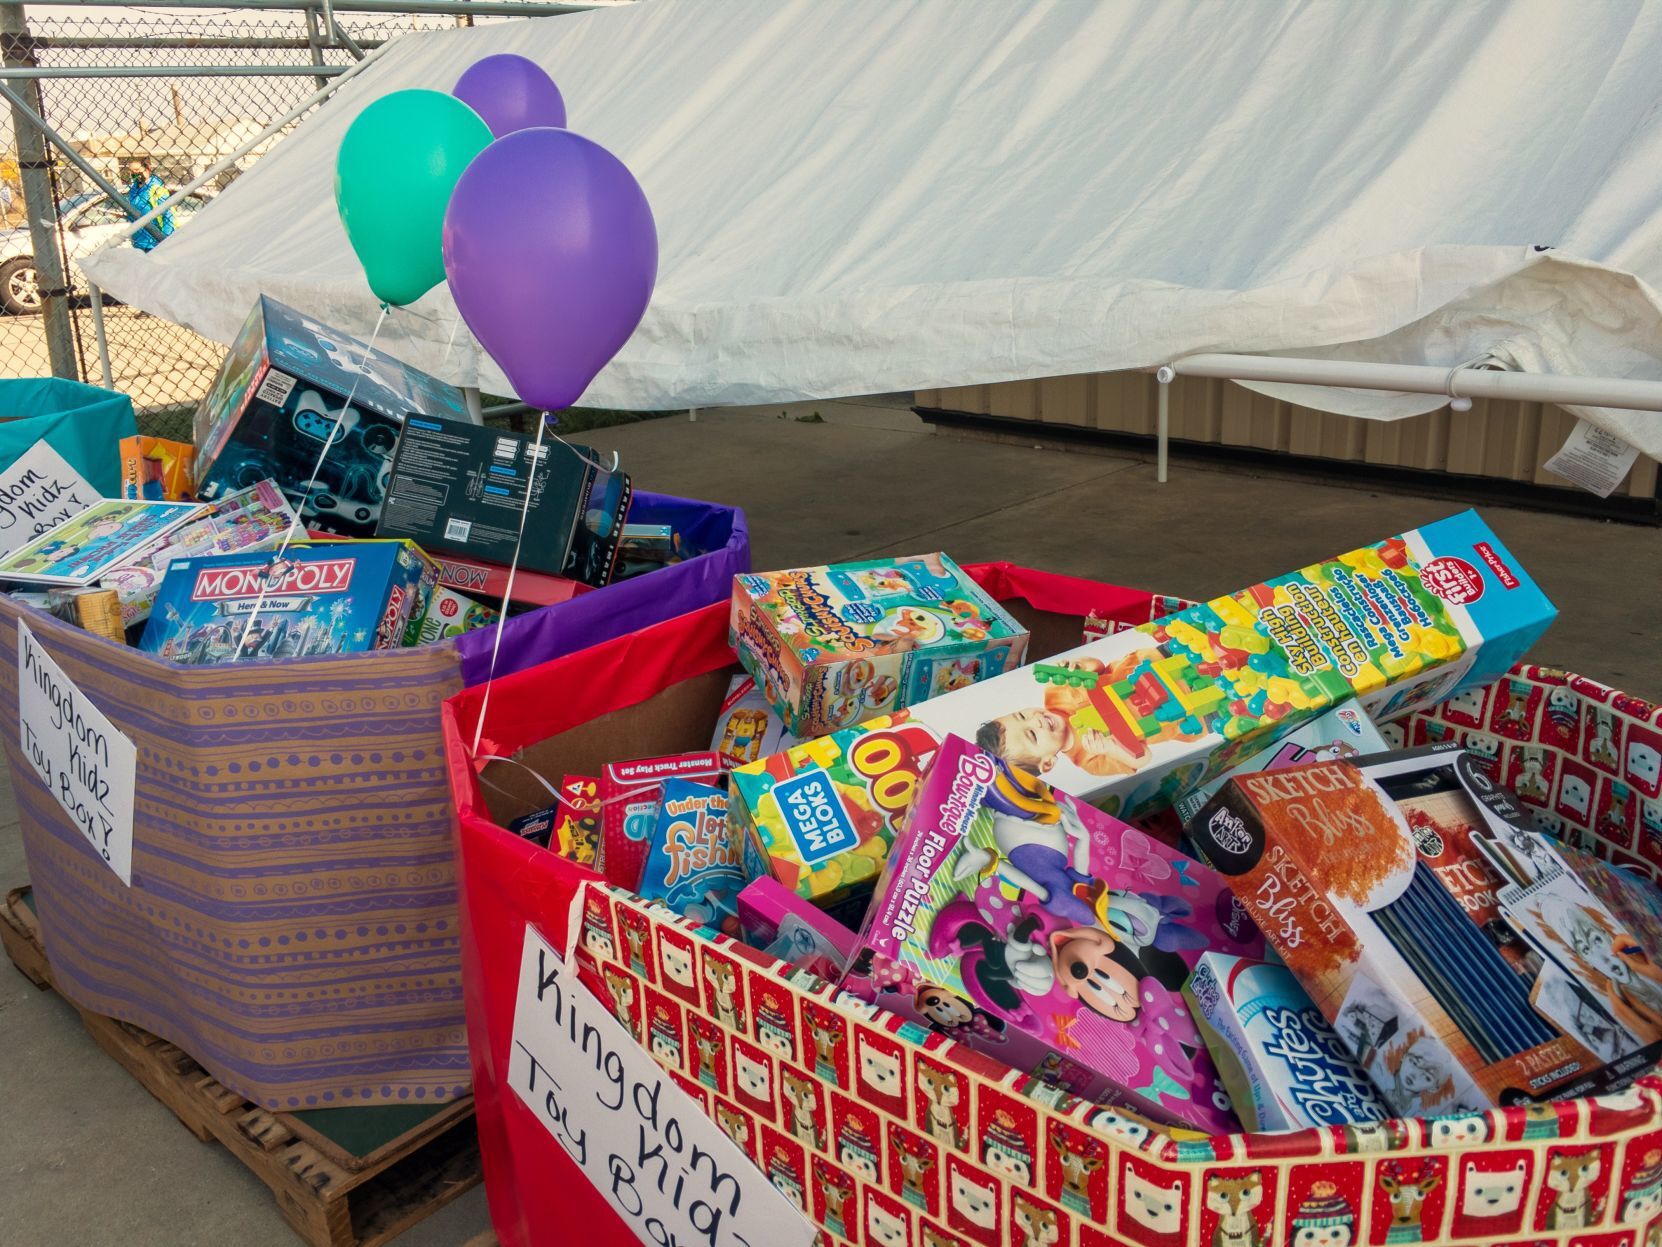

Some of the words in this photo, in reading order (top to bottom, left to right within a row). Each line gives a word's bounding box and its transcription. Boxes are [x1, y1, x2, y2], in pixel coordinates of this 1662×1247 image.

[196, 562, 350, 597] MONOPOLY
[441, 564, 488, 590] MON
[1333, 569, 1380, 626] Construção
[1448, 561, 1475, 596] Builders
[269, 600, 290, 610] Now
[1261, 610, 1290, 646] High
[1306, 586, 1352, 646] hauteur
[1331, 587, 1379, 649] Rascacielos
[1373, 582, 1413, 627] Bauspaß
[1278, 605, 1328, 667] Building
[1287, 584, 1356, 675] Construction
[1347, 643, 1367, 663] en
[1379, 631, 1404, 659] Mega
[24, 630, 109, 768] Kingdom
[21, 718, 53, 787] Toy
[621, 767, 634, 775] Set
[636, 764, 655, 774] Play
[657, 761, 677, 772] Truck
[680, 758, 712, 769] Monster
[68, 736, 115, 818] Kidz
[971, 784, 985, 808] Minnie
[1246, 765, 1356, 805] SKETCH
[666, 798, 709, 816] Under
[788, 788, 826, 851] MEGA
[804, 781, 844, 844] BLOKS
[960, 807, 976, 834] Mouse
[1286, 798, 1375, 846] Bliss
[917, 830, 946, 879] Floor
[891, 878, 930, 941] Puzzle
[1256, 873, 1304, 948] Bliss
[1266, 845, 1347, 942] SKETCH
[1241, 897, 1269, 932] DELUXE
[1265, 927, 1280, 945] ART
[1277, 943, 1293, 962] KIT
[538, 949, 741, 1217] Kingdom
[1267, 1009, 1352, 1127] Chutes
[1516, 1060, 1530, 1077] 2
[1531, 1046, 1569, 1072] PASTEL
[1253, 1111, 1272, 1133] Down
[1341, 1092, 1365, 1118] and
[516, 1040, 587, 1165] Toy
[608, 1153, 680, 1247] Bo
[639, 1124, 750, 1247] Kid
